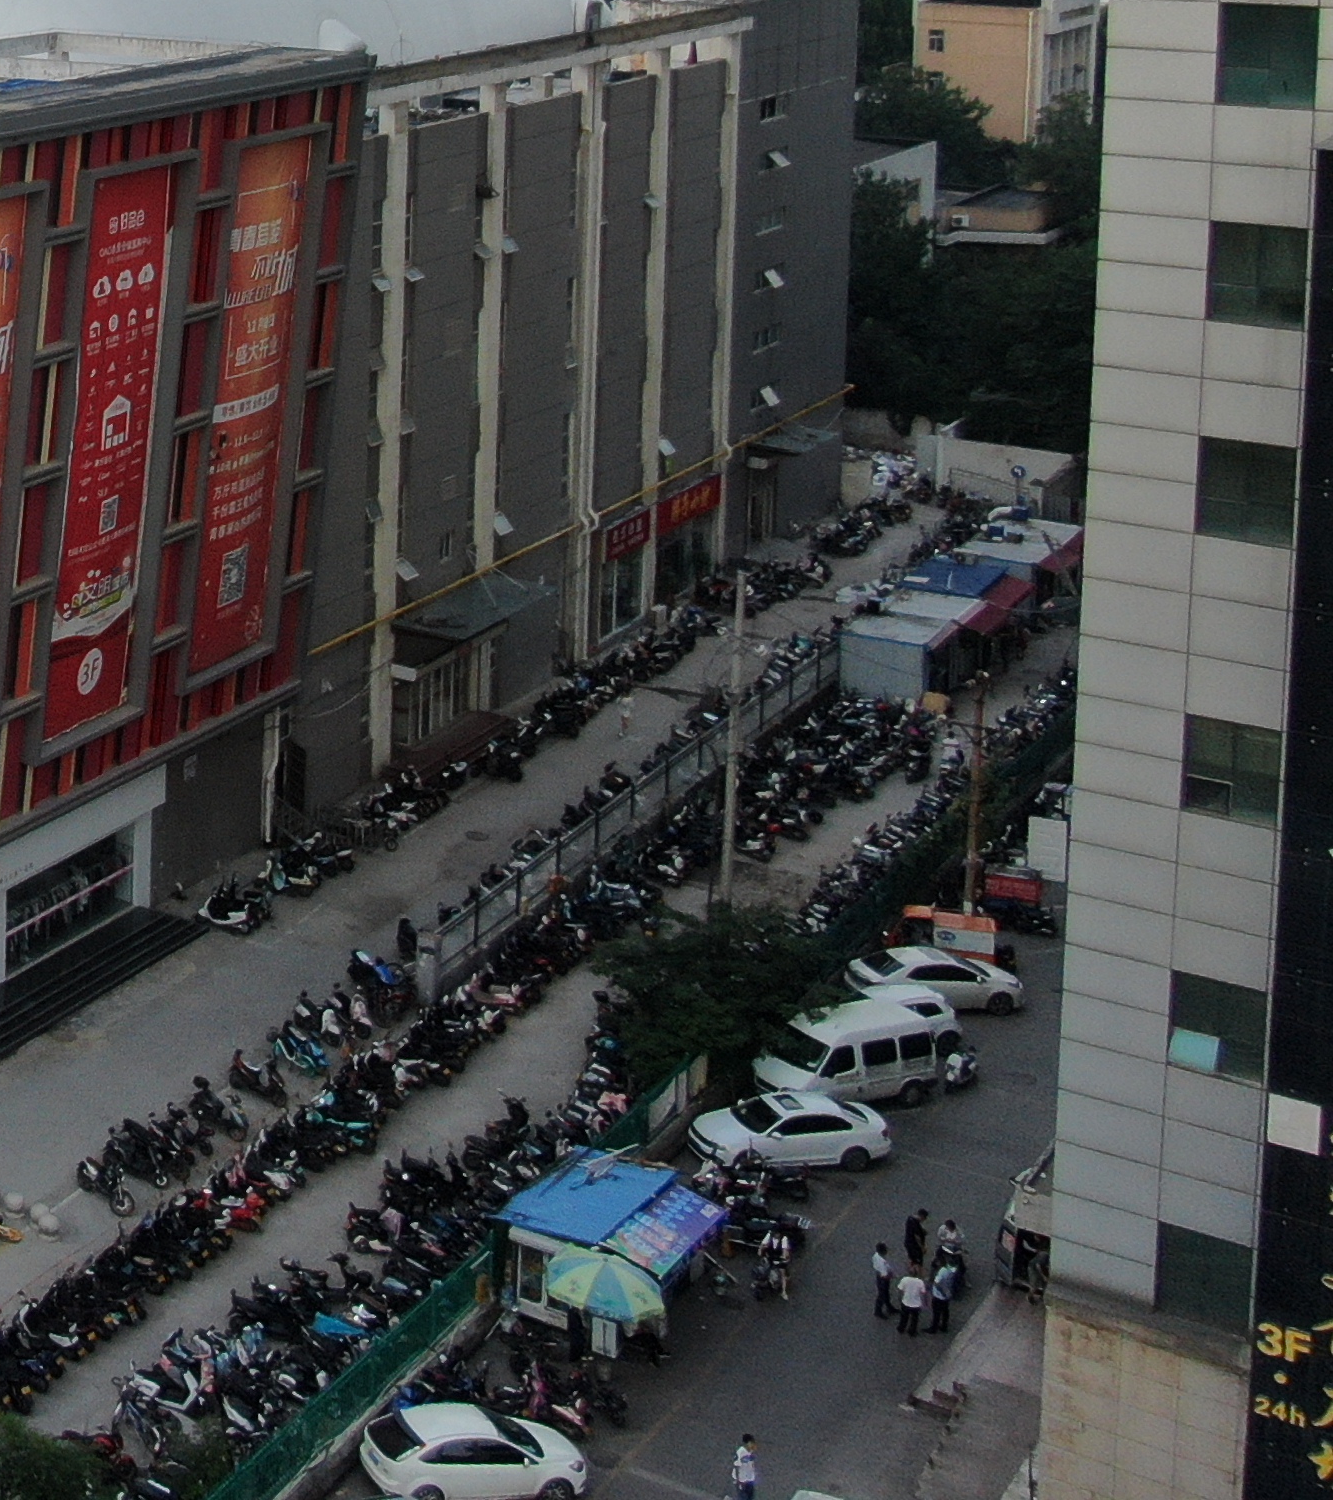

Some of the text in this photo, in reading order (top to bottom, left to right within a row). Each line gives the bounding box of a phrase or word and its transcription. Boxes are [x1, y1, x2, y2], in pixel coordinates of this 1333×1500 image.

[81, 657, 100, 687] 3F
[1256, 1322, 1312, 1363] 3F
[1253, 1394, 1306, 1429] 24h
